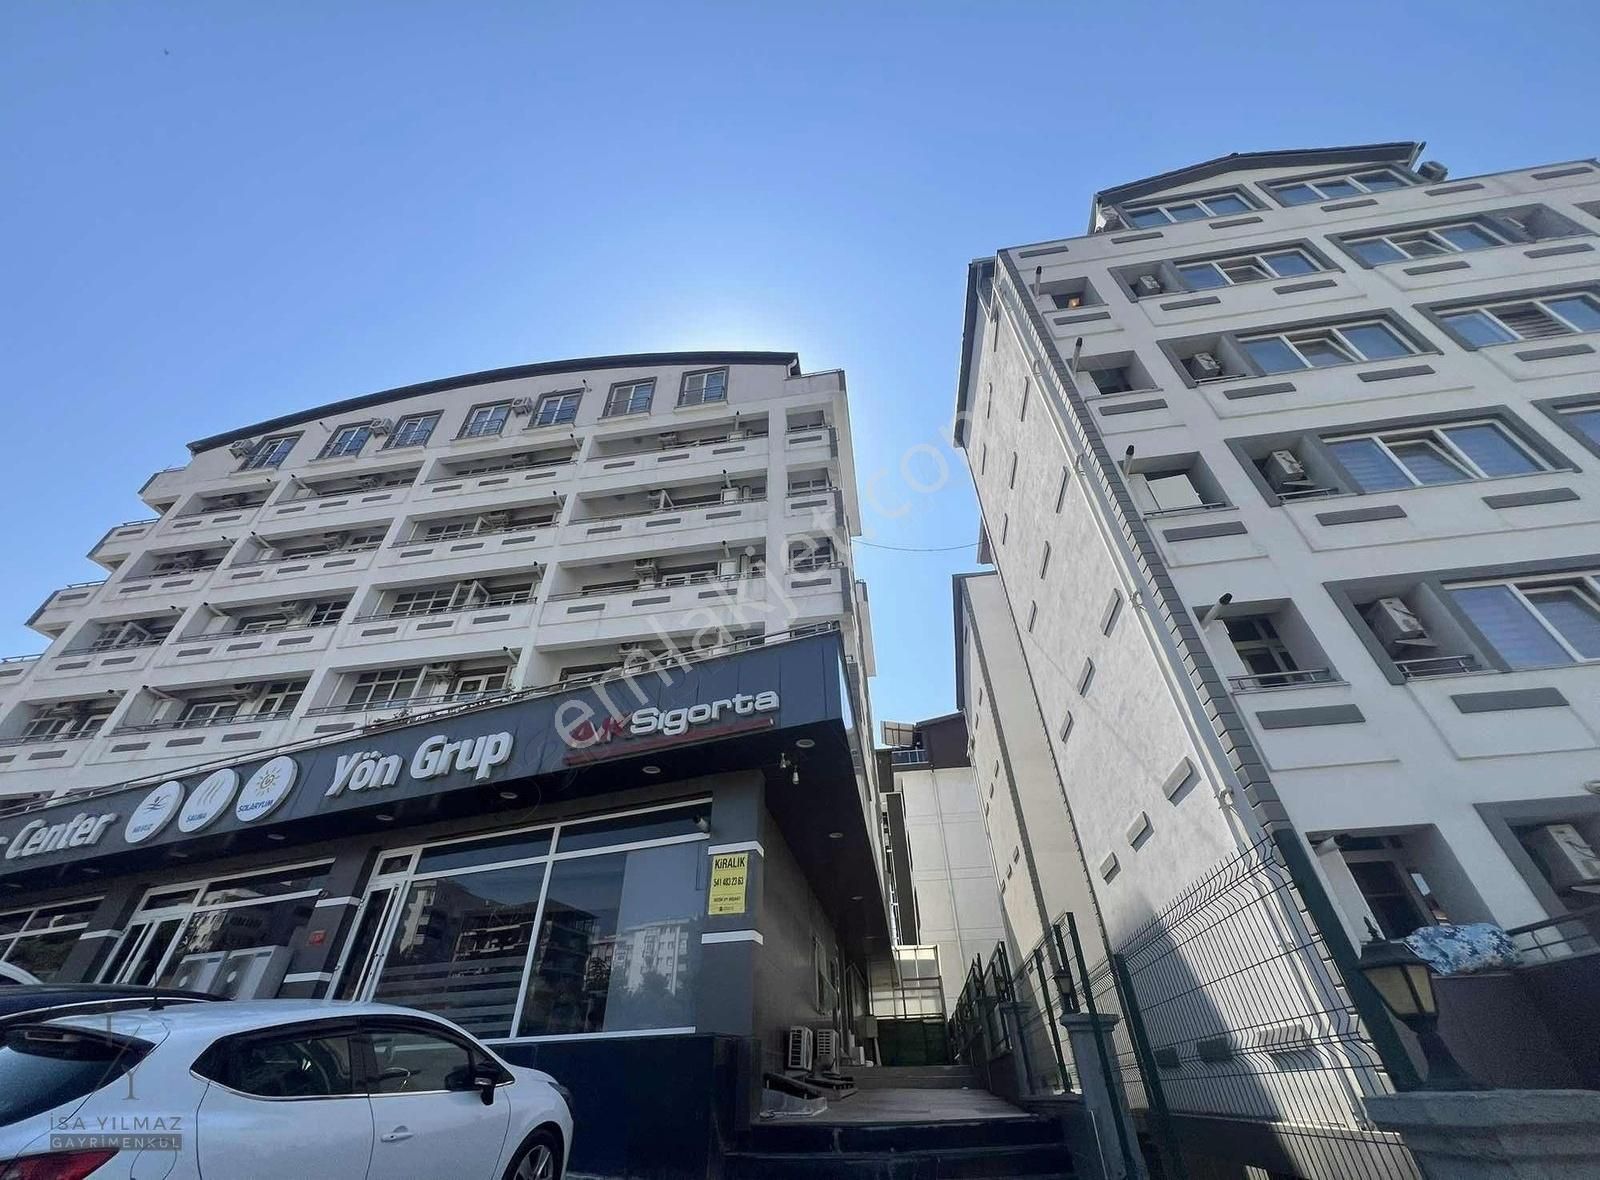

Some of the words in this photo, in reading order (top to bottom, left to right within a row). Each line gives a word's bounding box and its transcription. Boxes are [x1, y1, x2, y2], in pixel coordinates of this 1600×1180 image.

[324, 750, 404, 799] Yön
[410, 731, 513, 783] Grup
[5, 812, 118, 859] Center
